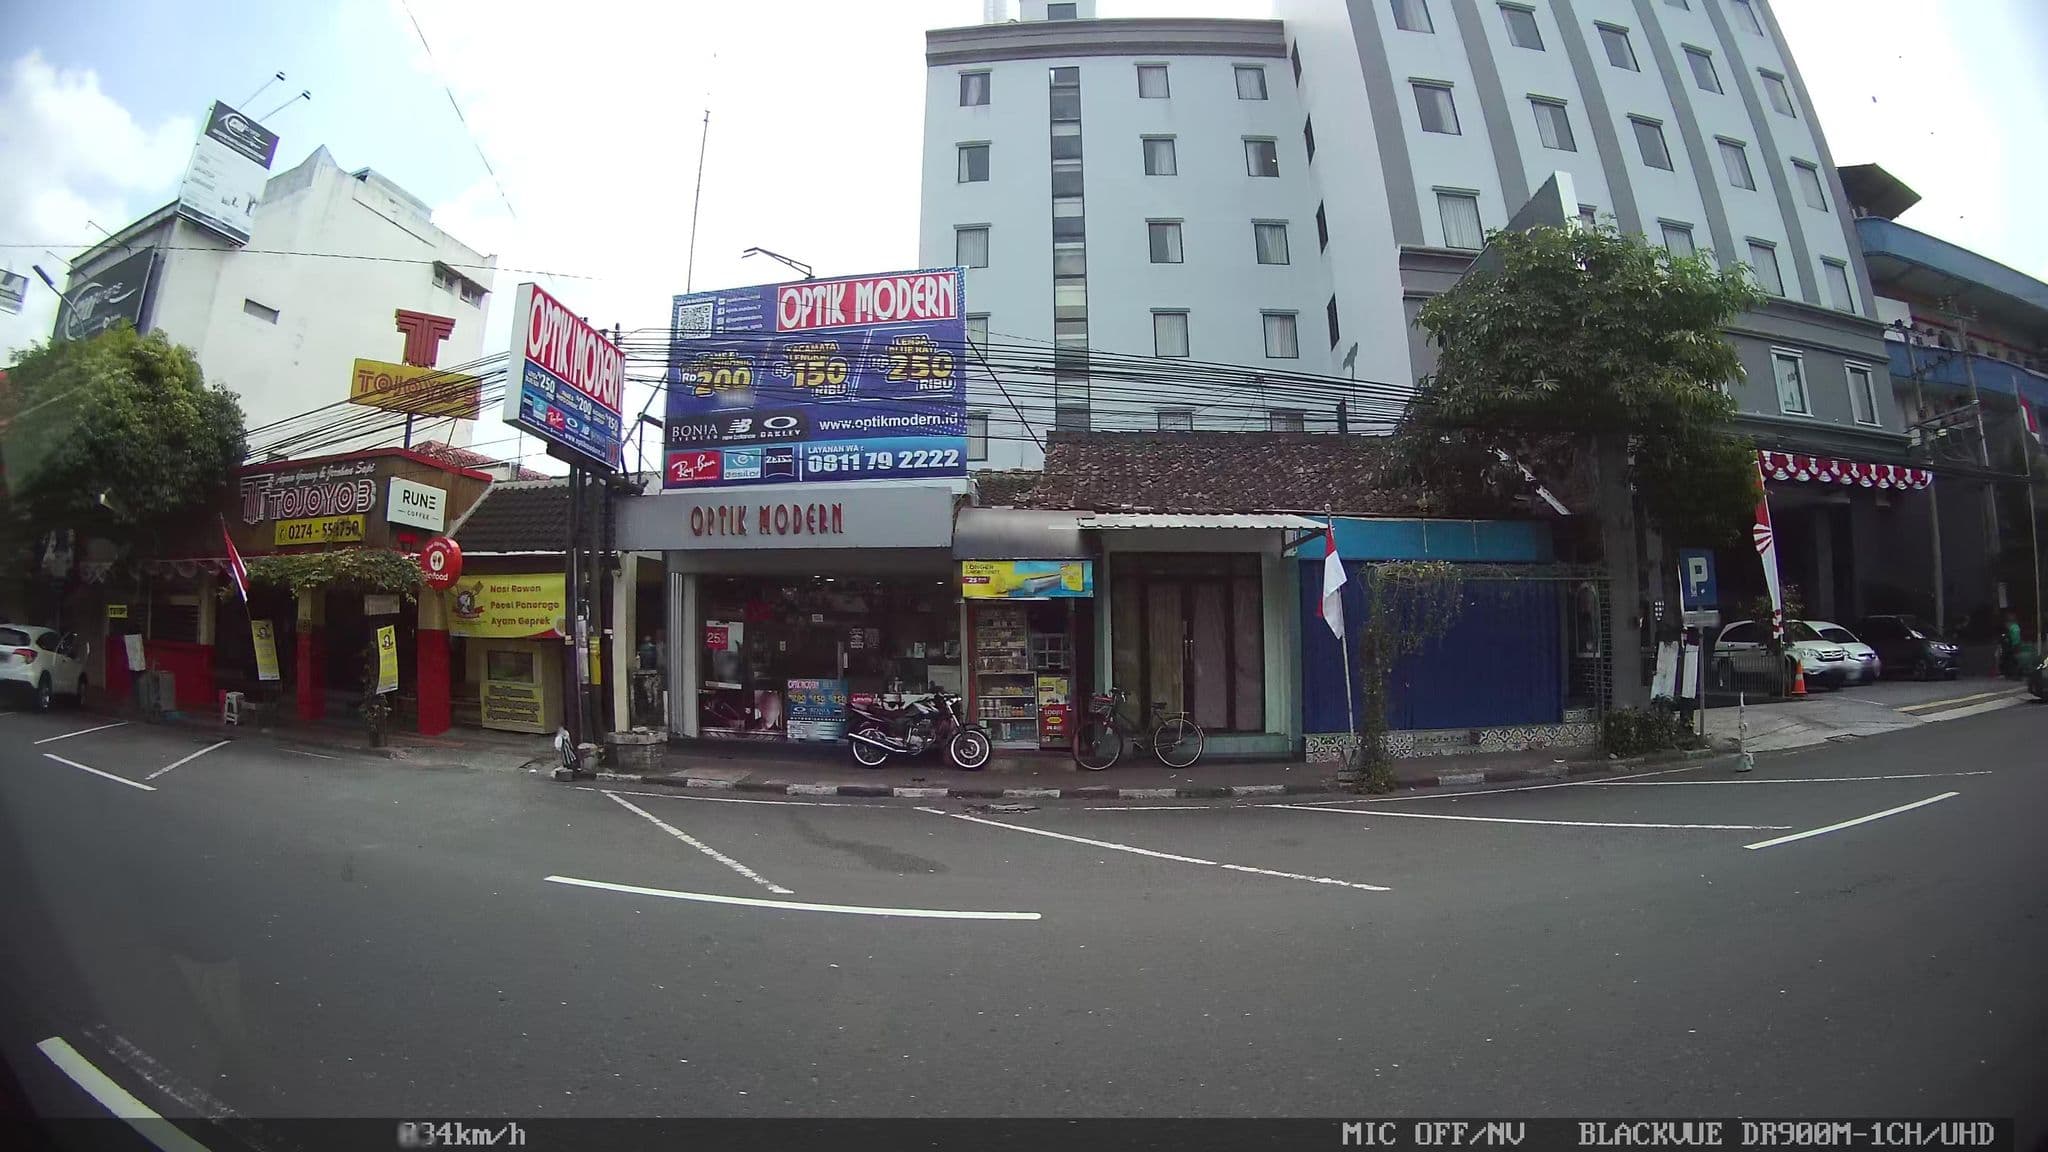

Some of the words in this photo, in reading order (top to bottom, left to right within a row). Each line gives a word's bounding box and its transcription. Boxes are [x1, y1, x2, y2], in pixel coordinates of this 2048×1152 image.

[779, 283, 846, 329] OPTIK
[855, 273, 955, 323] MODERN
[528, 293, 574, 376] OPTIK
[568, 321, 625, 414] MODERN
[793, 359, 847, 387] 150
[887, 352, 953, 382] 250
[540, 374, 556, 394] 250
[695, 368, 752, 396] 200
[814, 385, 847, 396] RIBU
[919, 379, 953, 390] RIBU
[672, 424, 718, 437] BONIA
[819, 412, 958, 431] www.optikmodern.id
[760, 429, 801, 438] OAKLEY
[808, 446, 844, 454] LAYANAN
[671, 454, 716, 478] Ray-Ban
[807, 453, 860, 473] 0811
[865, 451, 893, 470] 79
[899, 449, 959, 468] 2222
[402, 489, 437, 510] RUNE
[407, 510, 430, 520] COFFEE
[690, 504, 749, 537] OPTIK
[759, 502, 844, 536] MODERN
[288, 523, 313, 540] 0274
[1688, 556, 1709, 597] P
[490, 584, 509, 593] Nasi
[491, 617, 516, 627] Ayam
[518, 616, 551, 627] Geprek
